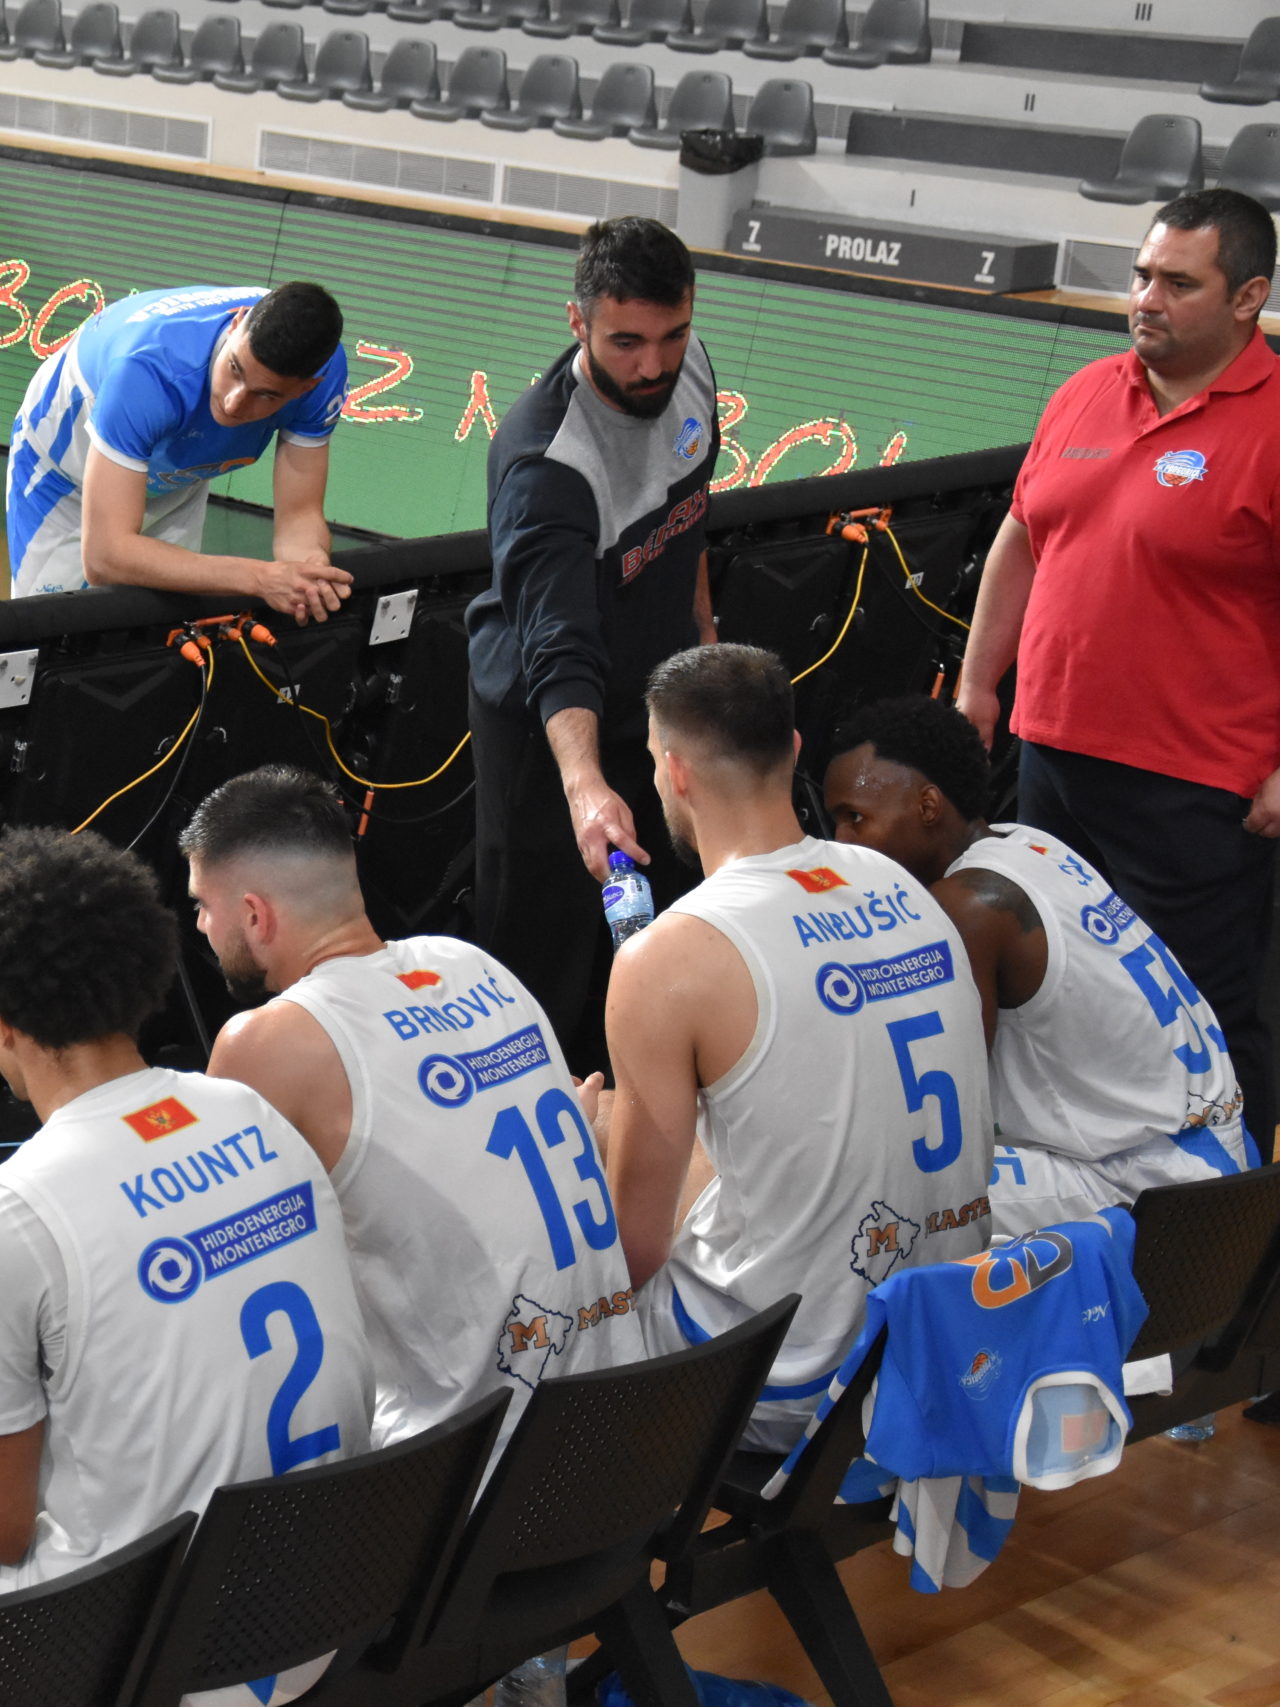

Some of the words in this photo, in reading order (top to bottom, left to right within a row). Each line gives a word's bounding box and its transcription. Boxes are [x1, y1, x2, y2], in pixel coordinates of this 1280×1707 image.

[748, 220, 761, 243] 7
[824, 233, 903, 266] PROLAZ
[980, 251, 995, 275] 7
[858, 949, 944, 982] HIDROENERGIJA
[867, 965, 945, 997] MONTENEGRO
[382, 968, 516, 1041] BRNOVIĆ
[466, 1031, 542, 1071] HIDROENERGIJA
[477, 1047, 547, 1085] MONTENEGRO
[885, 1011, 962, 1174] 5
[119, 1124, 279, 1219] KOUNTZ
[485, 1087, 618, 1272] 13
[199, 1193, 307, 1252] HIDROENERGIJA
[210, 1214, 307, 1270] MONTENEGRO
[866, 1221, 900, 1258] M
[507, 1314, 551, 1354] M
[239, 1280, 340, 1477] 2
